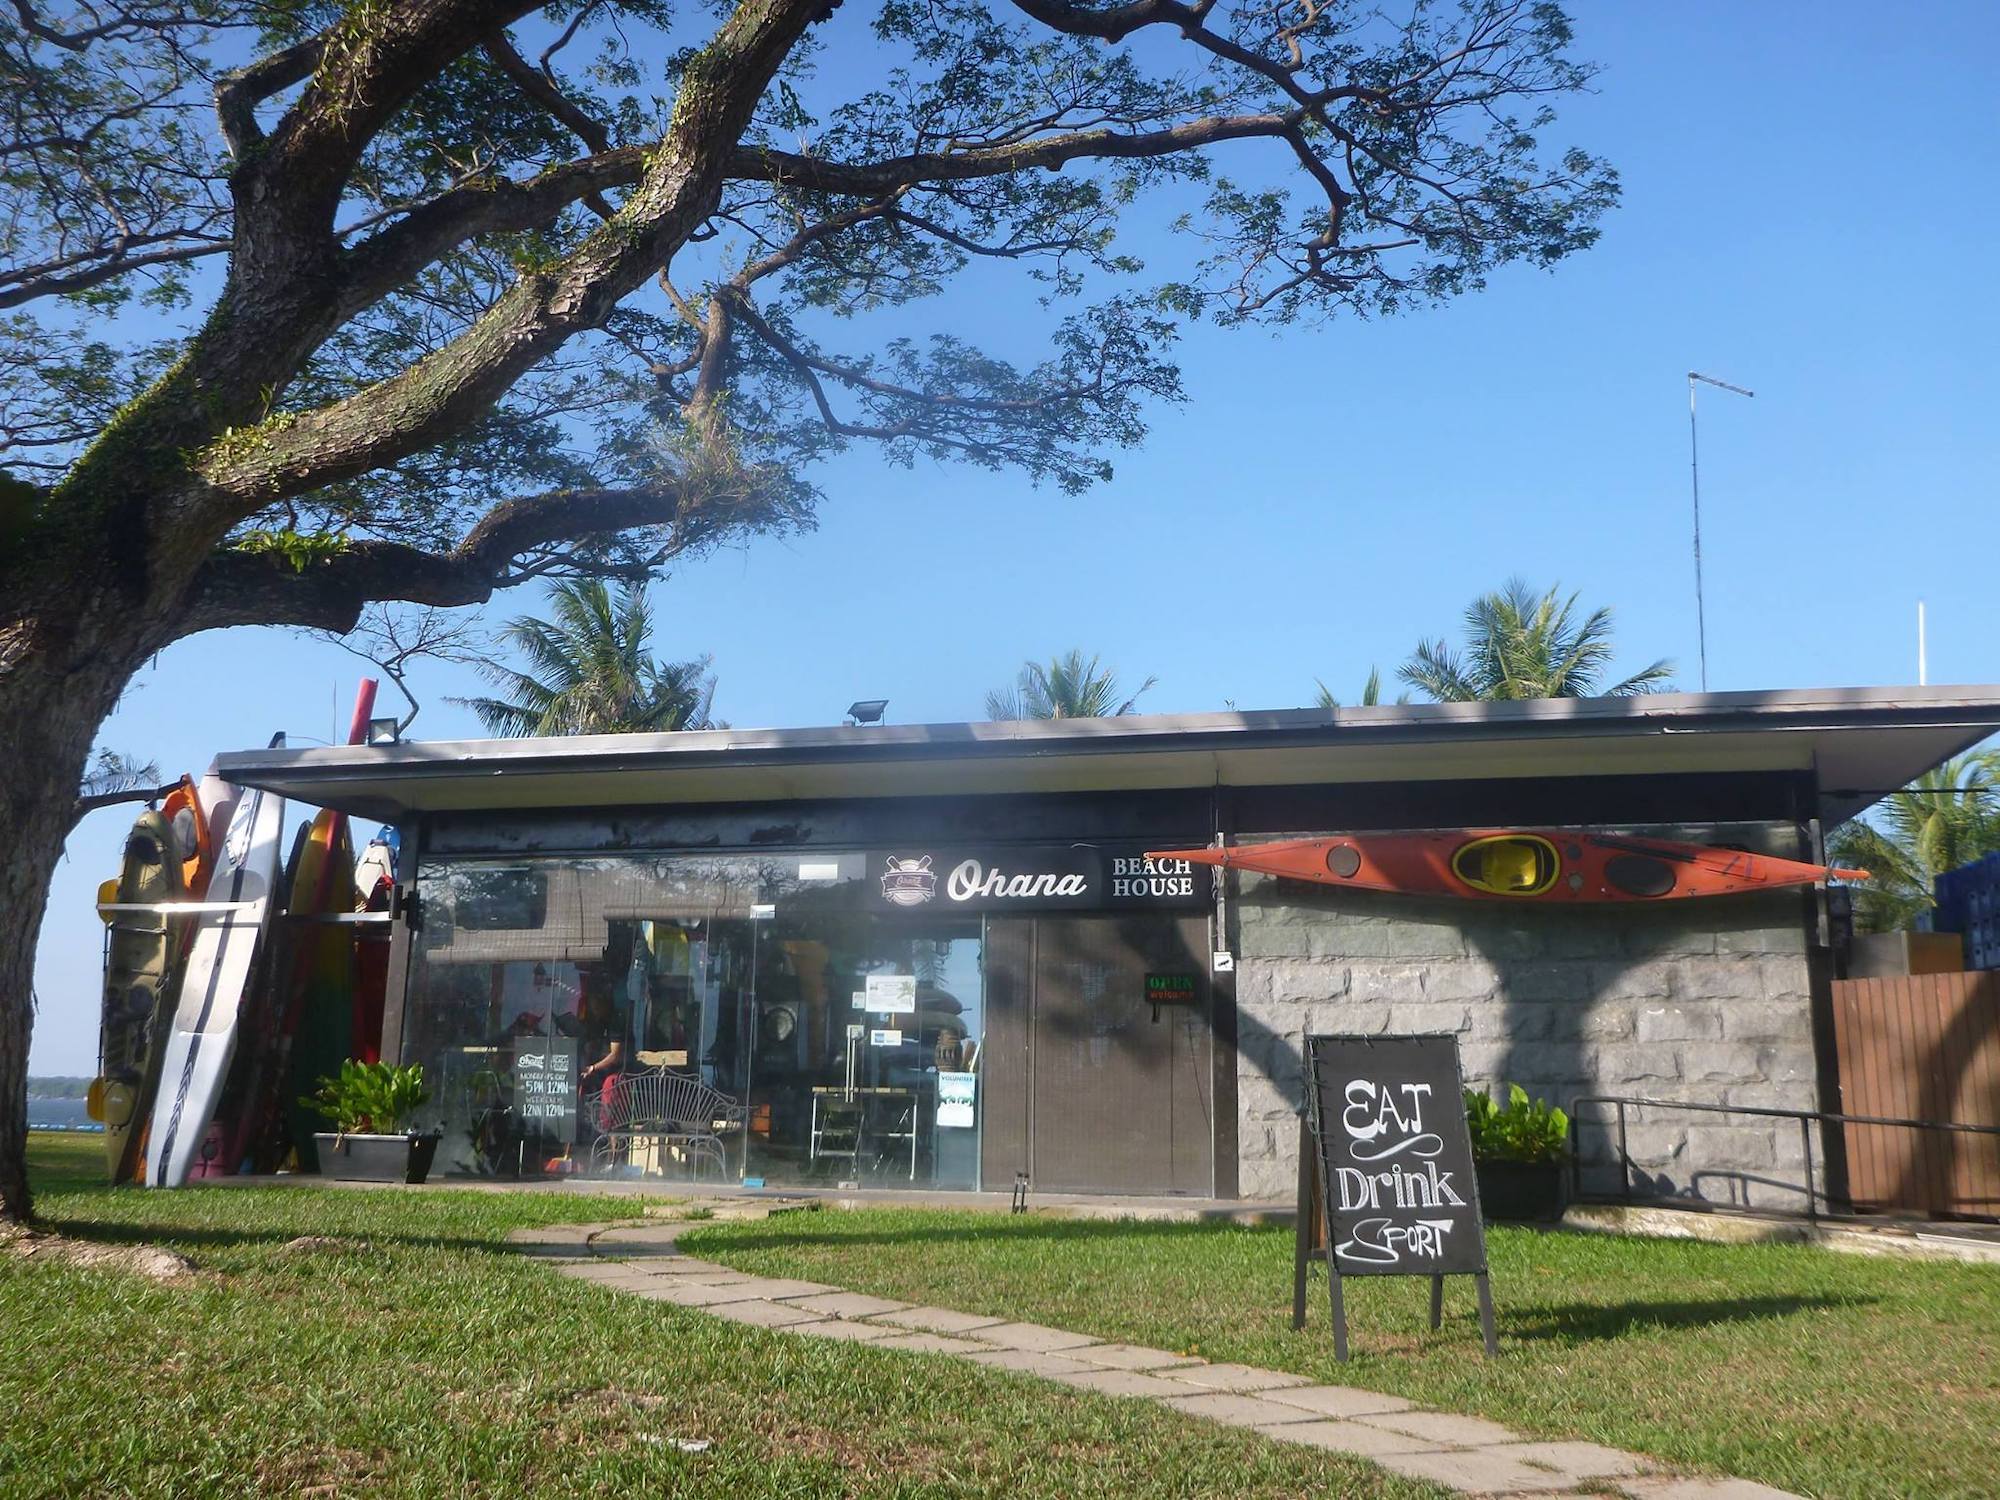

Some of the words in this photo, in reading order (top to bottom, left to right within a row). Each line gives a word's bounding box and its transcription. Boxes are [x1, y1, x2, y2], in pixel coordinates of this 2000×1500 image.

[947, 859, 1088, 901] Ohana
[1112, 857, 1192, 876] BEACH
[1112, 878, 1194, 897] HOUSE
[1343, 1079, 1432, 1139] EAT
[1335, 1161, 1467, 1210] Drink
